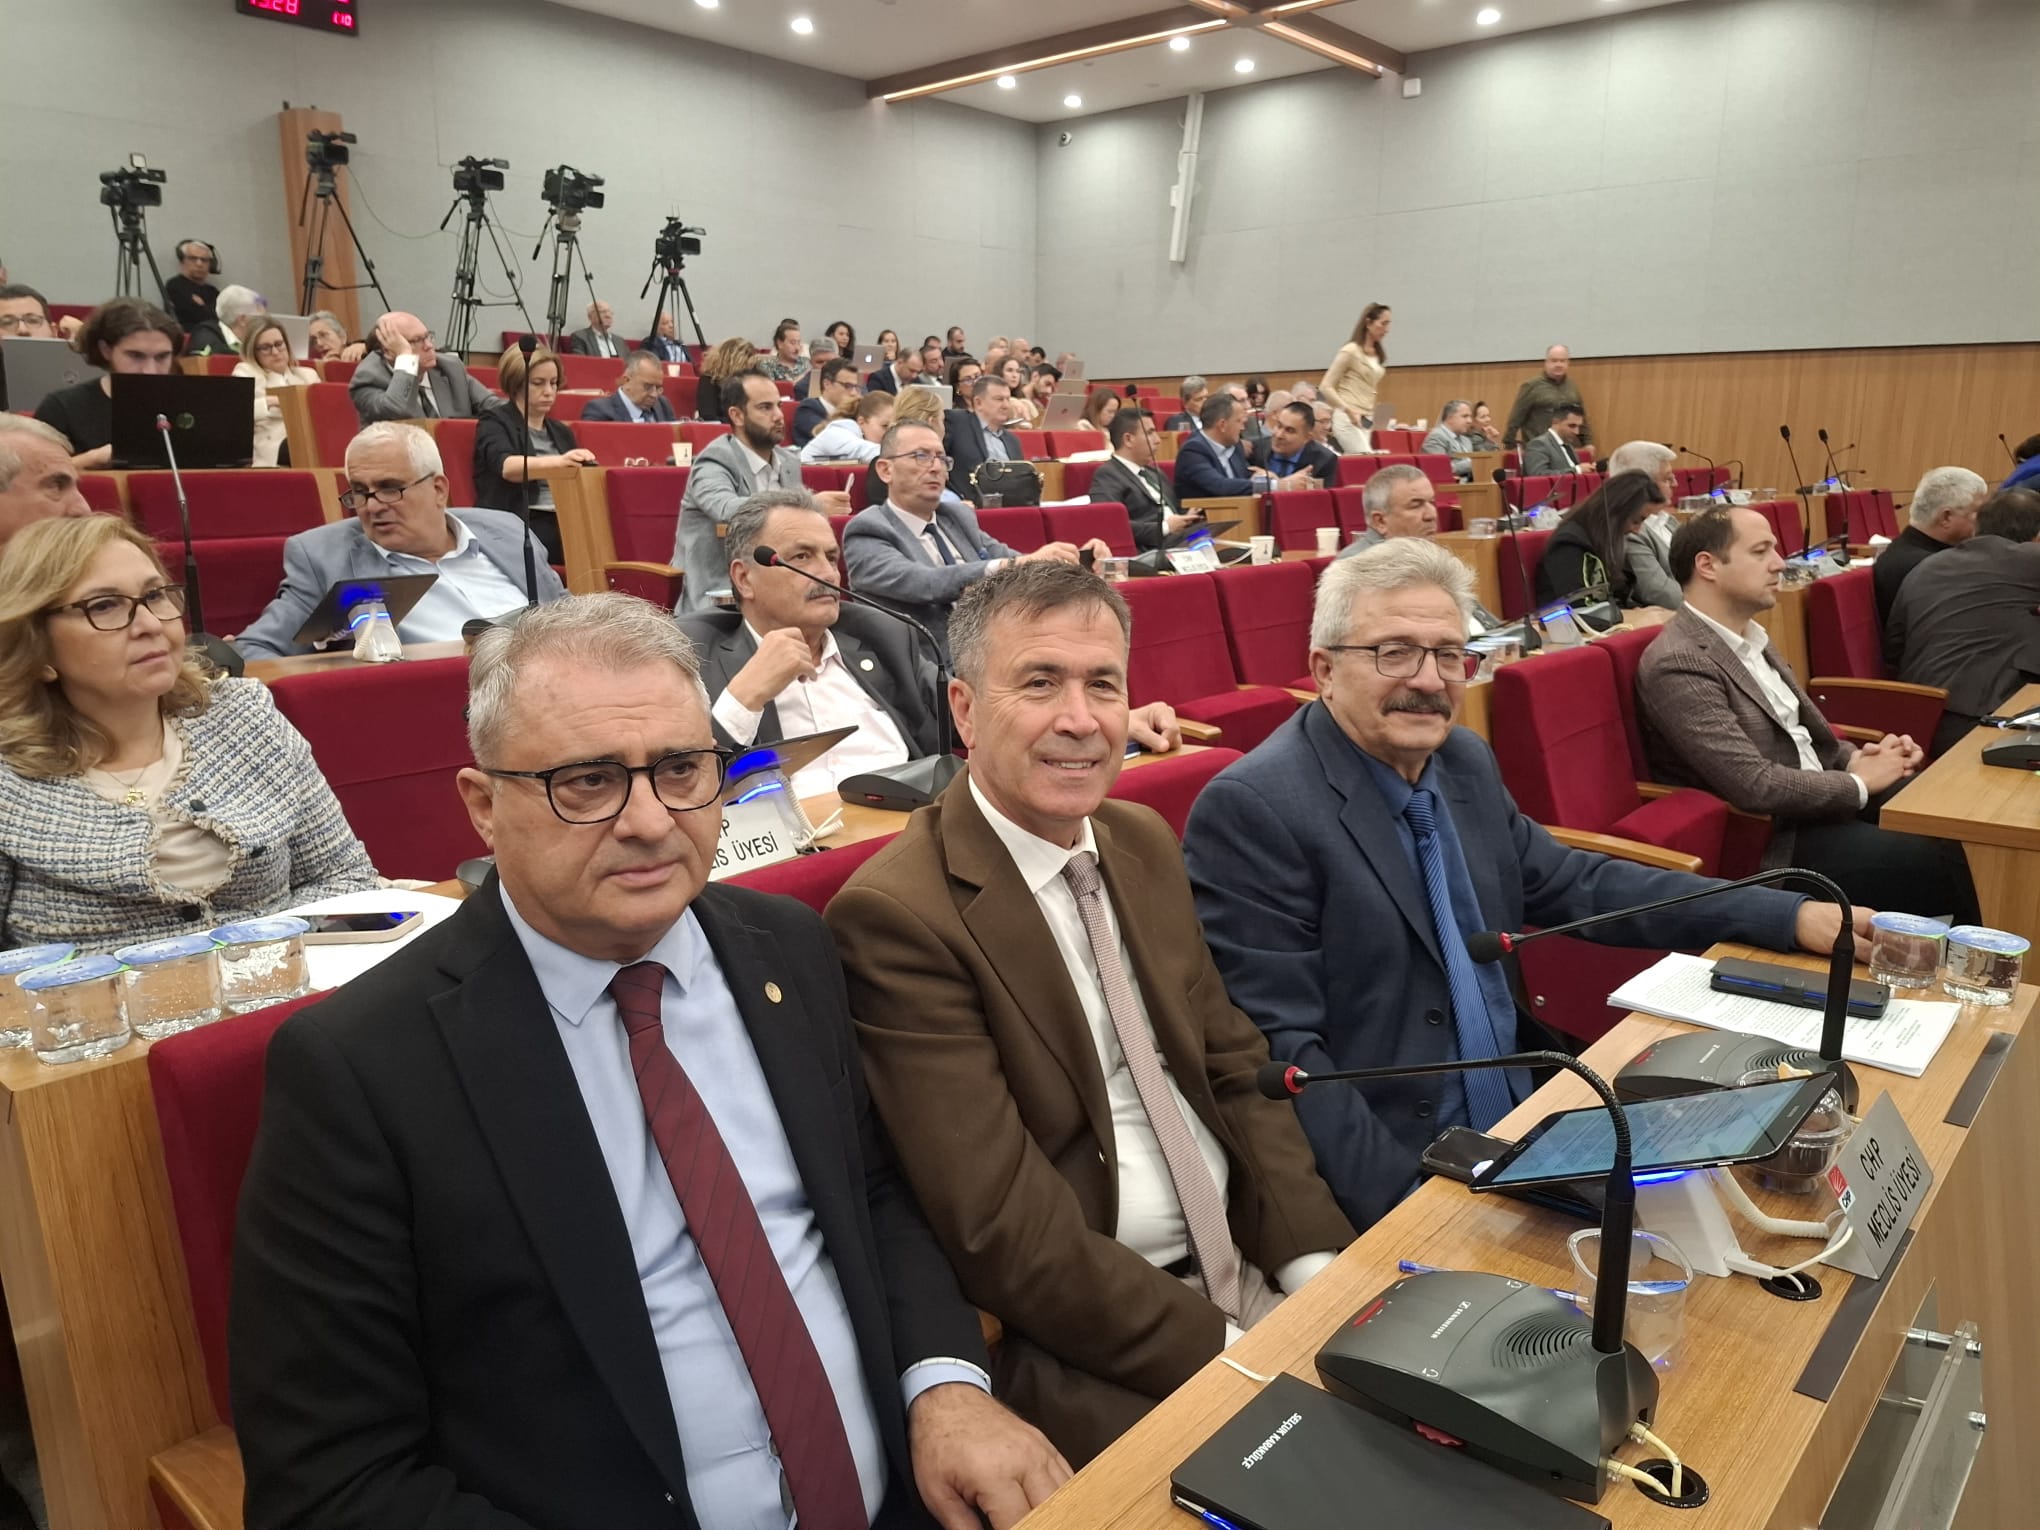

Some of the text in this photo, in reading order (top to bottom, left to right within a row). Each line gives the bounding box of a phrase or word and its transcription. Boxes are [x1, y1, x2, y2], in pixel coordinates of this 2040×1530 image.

[731, 831, 779, 861] ÜYESİ
[1859, 1137, 1885, 1181] CHP
[1866, 1146, 1922, 1249] MECLİS ÜYESİ
[1276, 1412, 1303, 1436] SELÇUK
